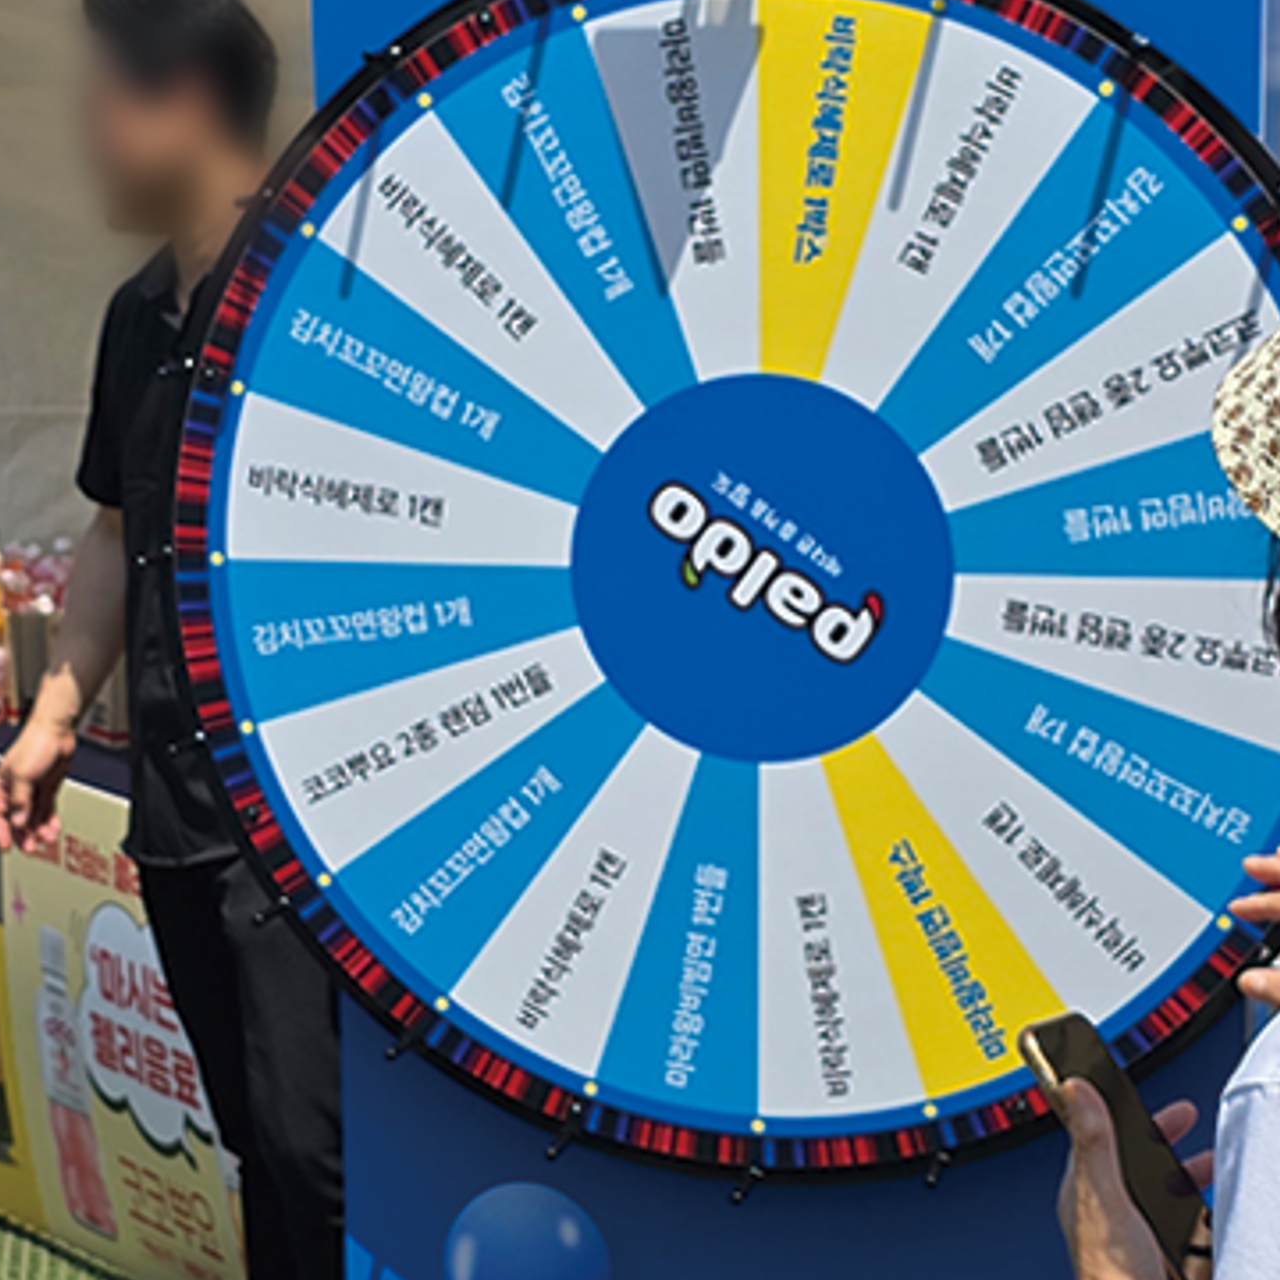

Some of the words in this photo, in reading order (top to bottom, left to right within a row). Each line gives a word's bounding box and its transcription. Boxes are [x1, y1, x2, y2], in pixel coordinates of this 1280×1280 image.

[802, 12, 858, 190] 비락식혜제로
[922, 65, 1021, 229] 비락식혜제로
[791, 194, 831, 265] 1박스
[897, 230, 939, 275] 1캔
[377, 174, 503, 307] 비락식혜제로
[496, 297, 537, 342] 1캔
[595, 254, 634, 302] 1개
[966, 318, 1014, 364] 1개
[1102, 365, 1151, 409] 2종
[458, 400, 501, 441] 1개
[1042, 389, 1103, 439] 랜덤
[247, 465, 399, 516] 비락식혜제로
[407, 494, 443, 527] 1캔
[645, 479, 886, 666] paldo
[432, 595, 473, 627] 1개
[1075, 611, 1132, 651] 랜덤
[1140, 624, 1186, 660] 2종
[395, 718, 439, 758] 2종
[438, 692, 492, 738] 랜덤
[1023, 702, 1068, 745] 1개
[519, 763, 563, 805] 1개
[982, 802, 1024, 845] 1캔
[885, 835, 935, 908] 1박스
[795, 894, 827, 932] 1캔
[1017, 837, 1146, 972] 비락식혜제로
[516, 889, 604, 1030] 비락식혜제로
[588, 849, 627, 889] 1캔
[803, 938, 851, 1097] 비락식혜제로
